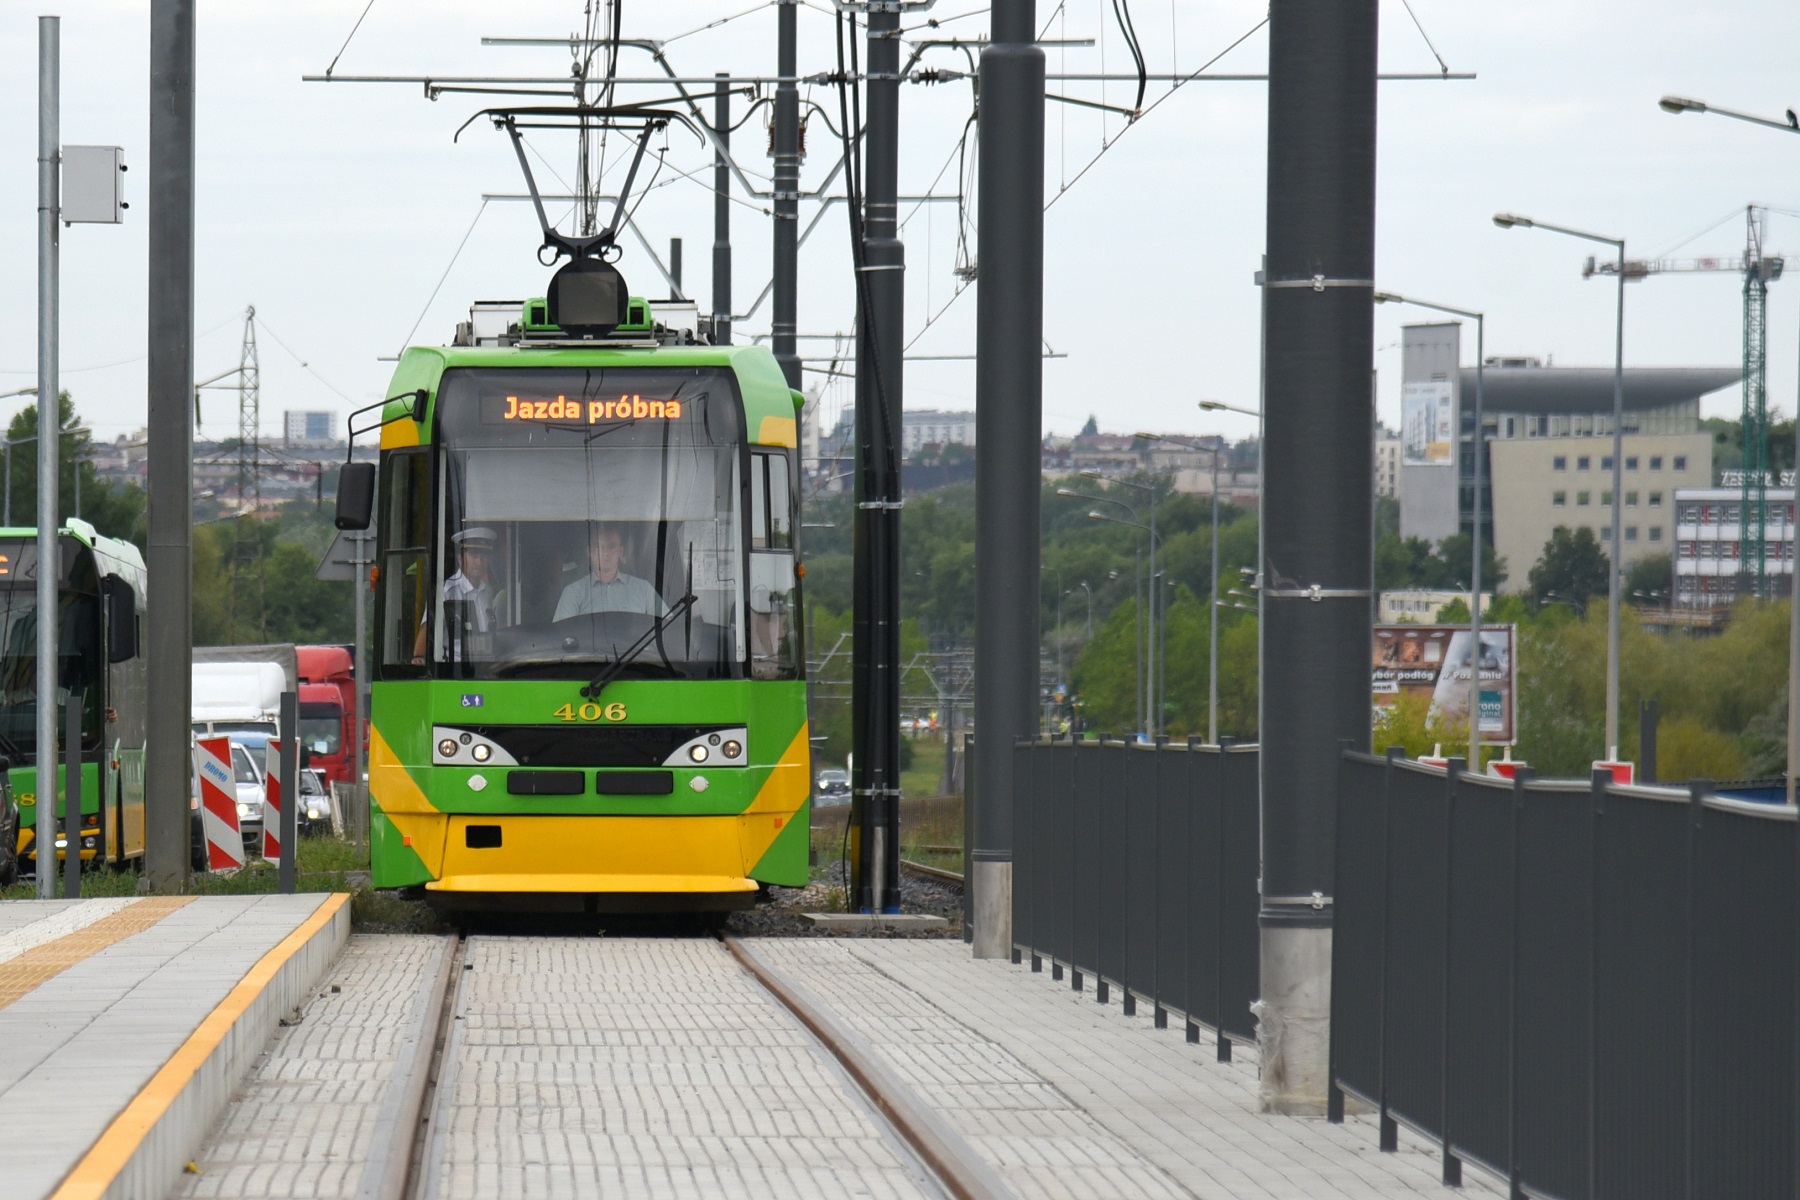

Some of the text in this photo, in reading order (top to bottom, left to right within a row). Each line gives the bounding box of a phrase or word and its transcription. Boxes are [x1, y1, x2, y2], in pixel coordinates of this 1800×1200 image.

[504, 394, 681, 424] Jazda próbna
[1721, 470, 1773, 486] ZESŁ
[1397, 670, 1434, 681] podłóg
[1453, 671, 1502, 680] Pozaniu
[552, 702, 627, 722] 406
[203, 761, 228, 782] DROMO
[13, 792, 36, 806] 8
